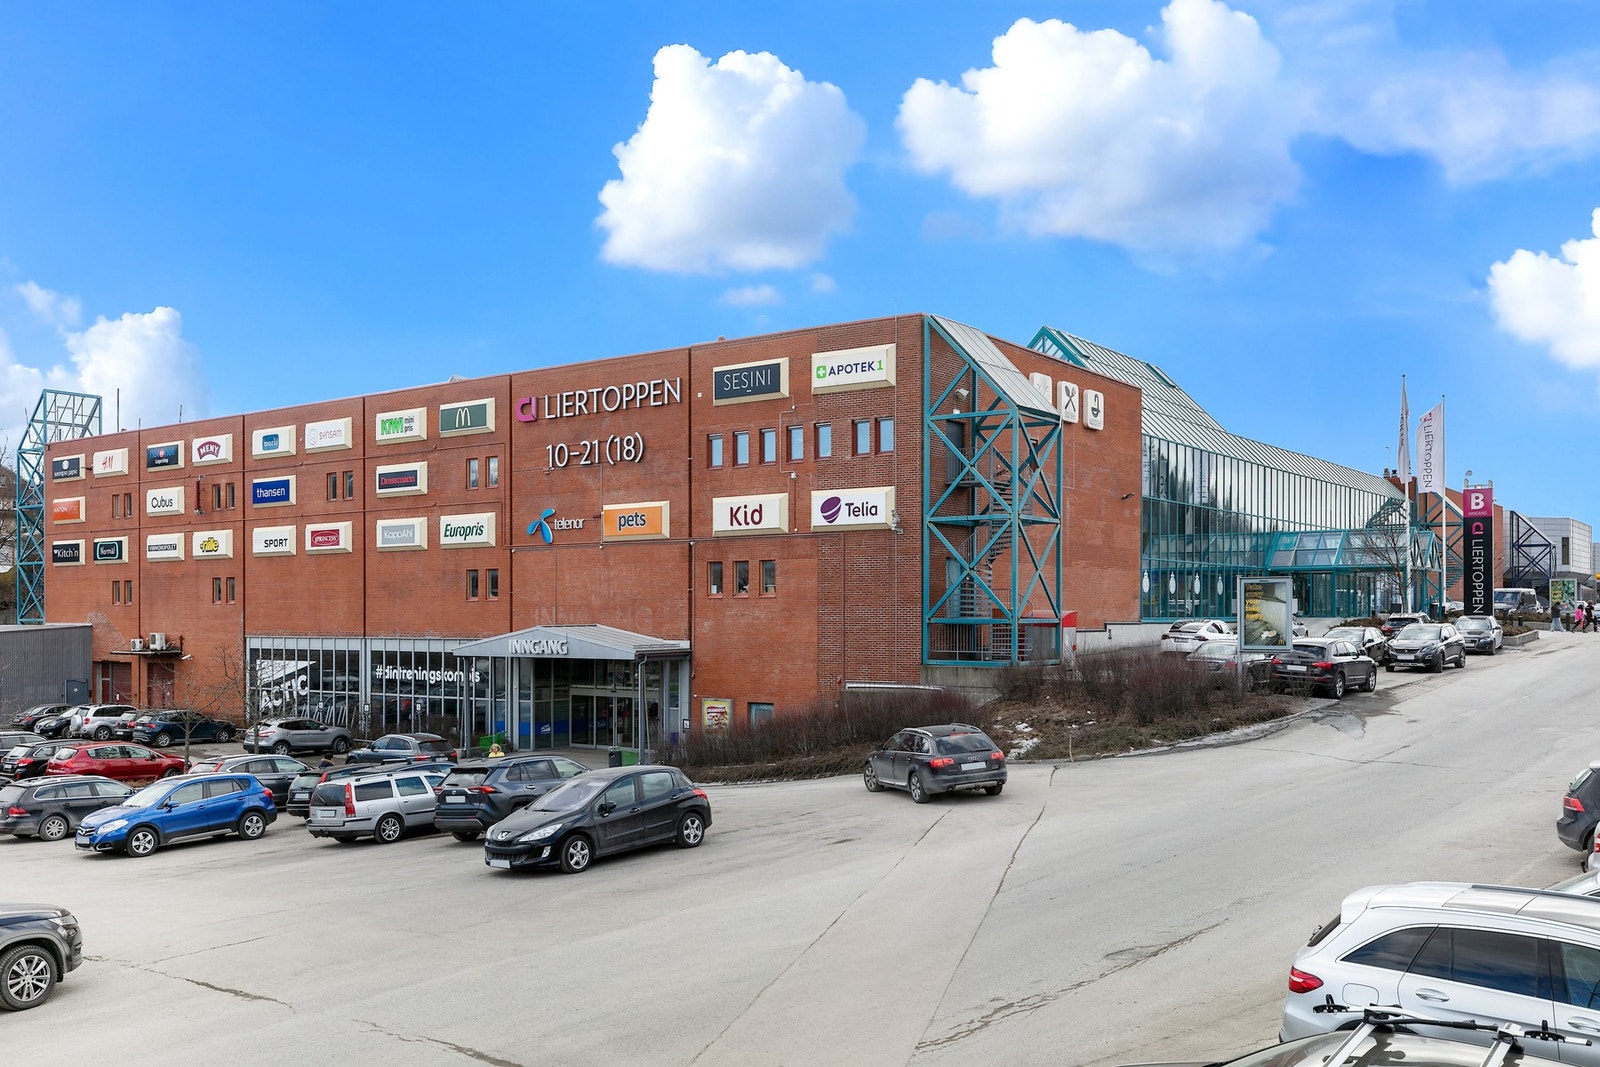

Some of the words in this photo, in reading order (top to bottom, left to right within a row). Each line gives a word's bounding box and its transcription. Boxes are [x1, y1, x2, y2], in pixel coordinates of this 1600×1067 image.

[722, 368, 772, 392] SESINI
[544, 376, 681, 419] LIERTOPPEN
[381, 417, 404, 435] KIWI
[404, 415, 414, 424] mini
[404, 424, 413, 433] pris
[200, 444, 219, 455] MENY
[605, 431, 644, 465] (18)
[1423, 424, 1434, 488] LIERTOPPEN
[256, 487, 286, 498] thansen
[1470, 492, 1484, 510] B
[151, 496, 173, 509] Cubus
[845, 500, 878, 518] Telia
[553, 516, 585, 531] telenor
[617, 511, 646, 531] pets
[728, 502, 763, 527] Kid
[384, 529, 413, 539] KappAhl
[443, 522, 484, 541] Europris
[264, 538, 288, 548] SPORT
[1471, 539, 1484, 614] LIERTOPPEN
[508, 639, 568, 655] INNGANG
[375, 664, 480, 684] #dintreningskomis
[260, 674, 308, 712] ACTIC
